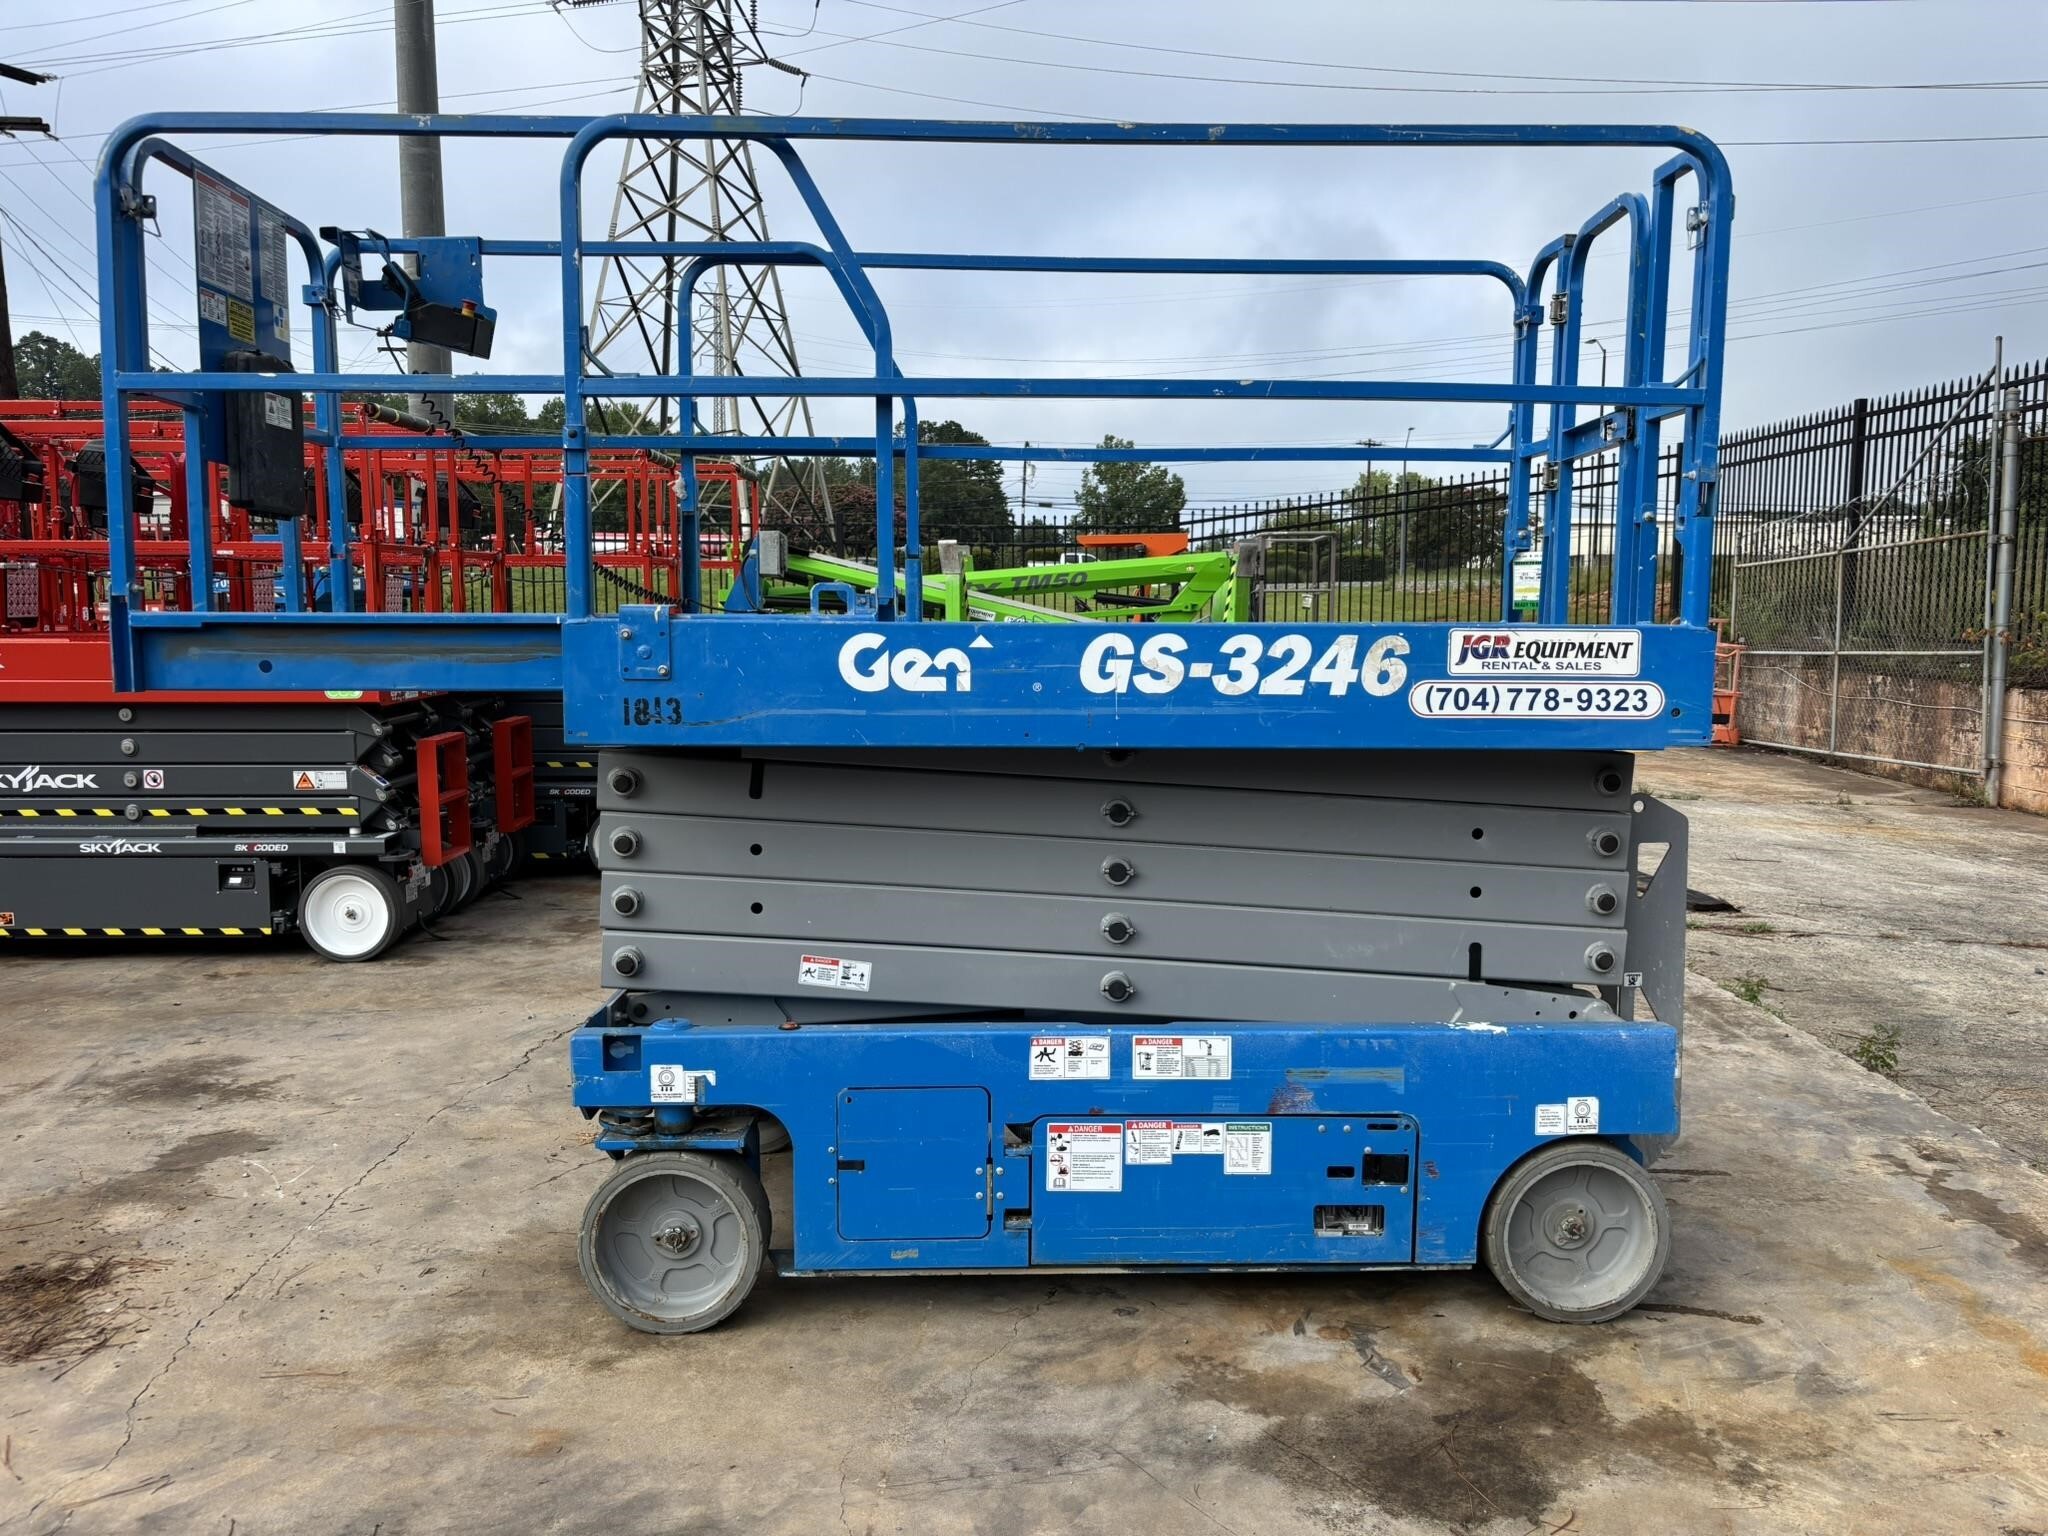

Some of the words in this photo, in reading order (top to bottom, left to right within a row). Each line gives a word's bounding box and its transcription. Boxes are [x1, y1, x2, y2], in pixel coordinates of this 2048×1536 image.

[1011, 571, 1088, 591] TM50
[967, 607, 994, 619] QUIPMENT
[1454, 634, 1511, 666] JGR
[1513, 641, 1633, 664] EQUIPMENT
[838, 632, 993, 692] Gen
[1079, 632, 1411, 697] GS-3246
[1481, 661, 1537, 670] RENTAL
[1541, 661, 1551, 670] &
[1555, 661, 1602, 671] SALES
[1425, 685, 1500, 713] (704)
[1507, 687, 1648, 712] 778-9323
[623, 697, 682, 726] 1813
[79, 838, 162, 855] SKYJACK
[1038, 1038, 1063, 1046] DANGER
[1148, 1038, 1173, 1046] DANGER
[1074, 1125, 1103, 1133] DANGER
[1138, 1121, 1167, 1129] DANGER
